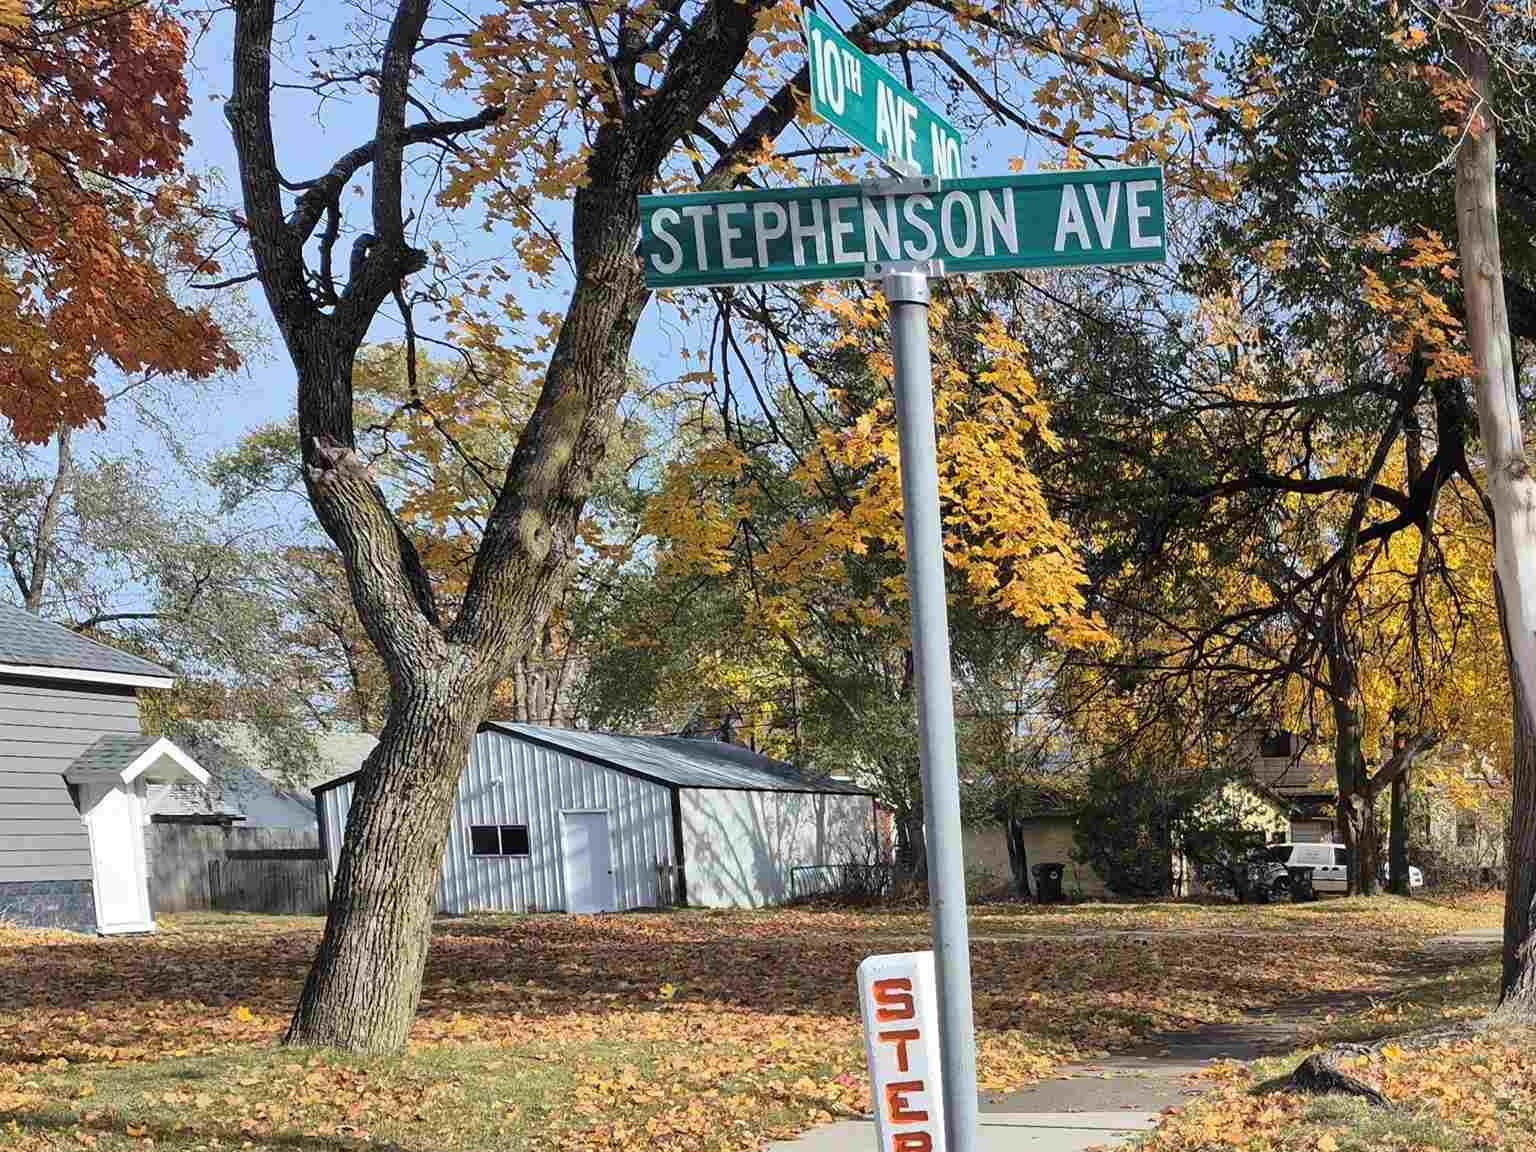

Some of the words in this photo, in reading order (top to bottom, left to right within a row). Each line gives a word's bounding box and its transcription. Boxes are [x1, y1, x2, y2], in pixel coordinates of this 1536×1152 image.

[811, 28, 863, 119] 10TH
[875, 79, 919, 178] AVE
[930, 121, 963, 179] NO
[649, 186, 1020, 275] STEPHENSON
[1053, 179, 1163, 253] AVE
